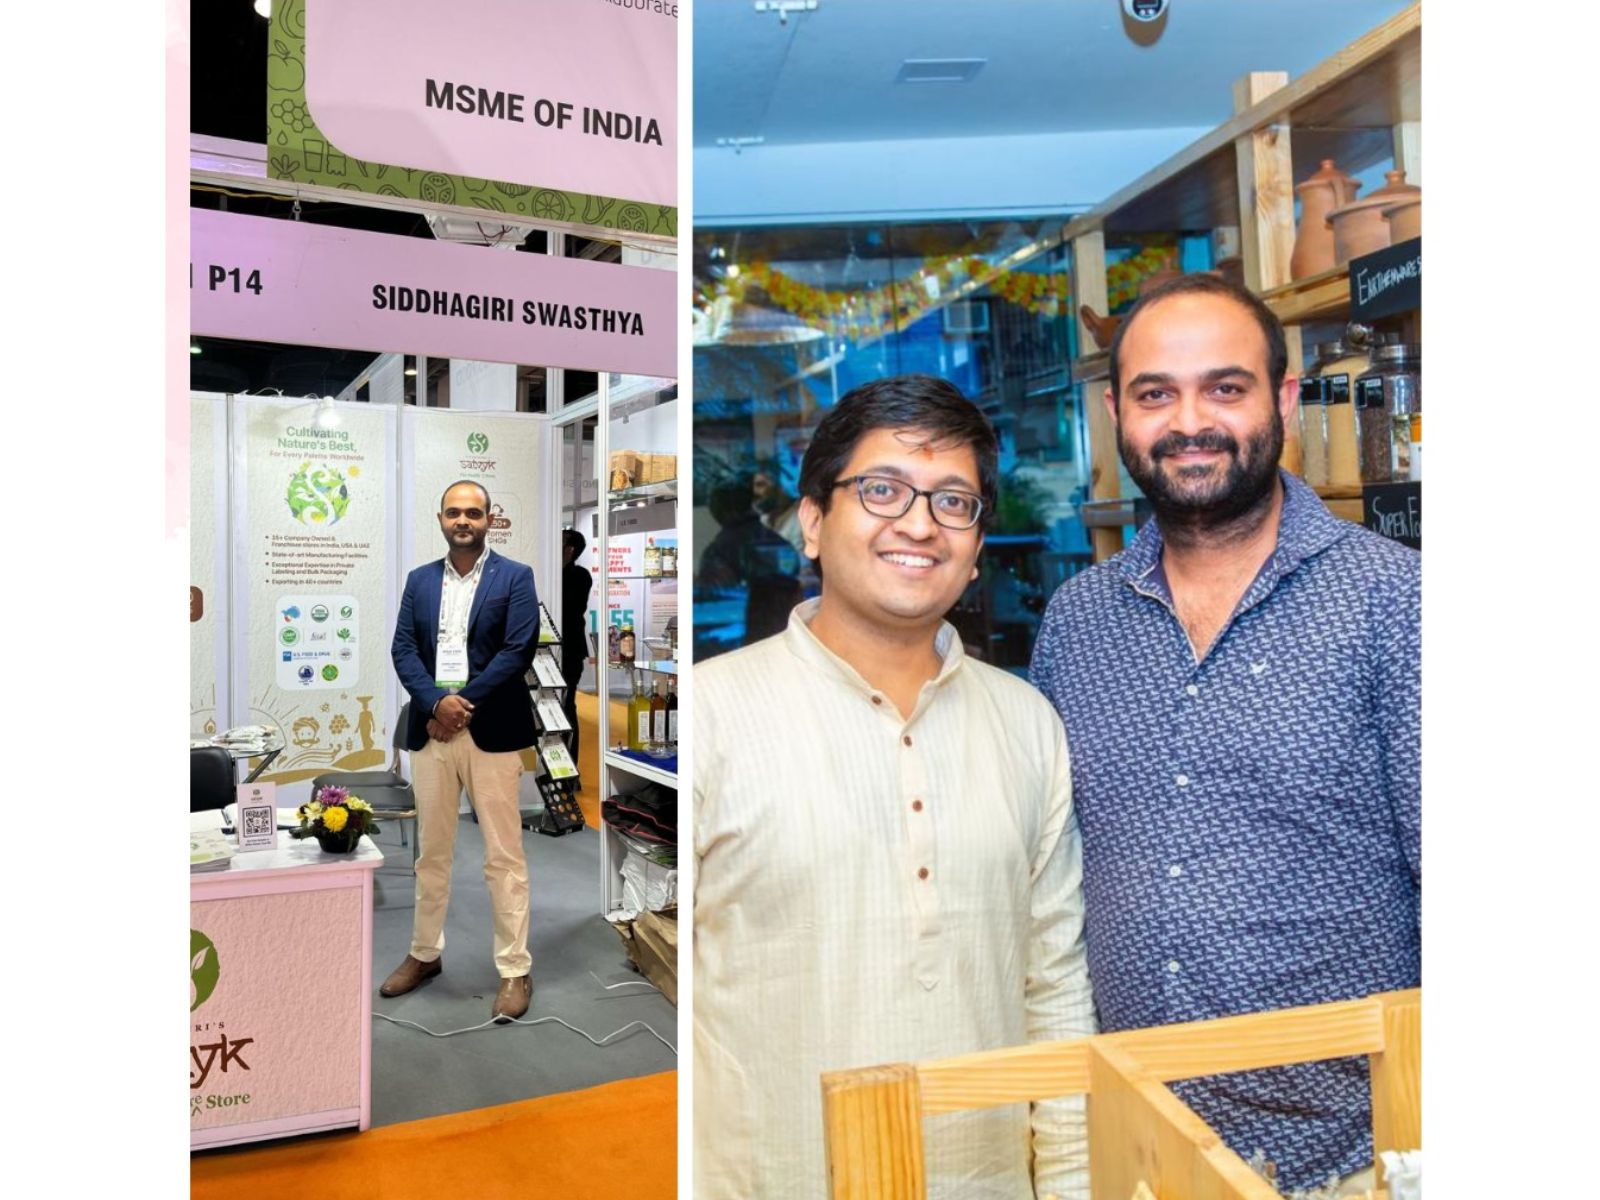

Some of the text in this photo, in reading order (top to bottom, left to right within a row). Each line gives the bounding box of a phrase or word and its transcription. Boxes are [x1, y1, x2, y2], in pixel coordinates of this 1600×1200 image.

[425, 78, 663, 146] MSME OF INDIA
[209, 264, 263, 295] P14
[372, 284, 644, 336] SIDDHAGIRI SWASTHYA
[286, 426, 349, 440] Cultivating
[278, 438, 357, 453] Nature's Best,
[206, 1093, 250, 1109] Store
